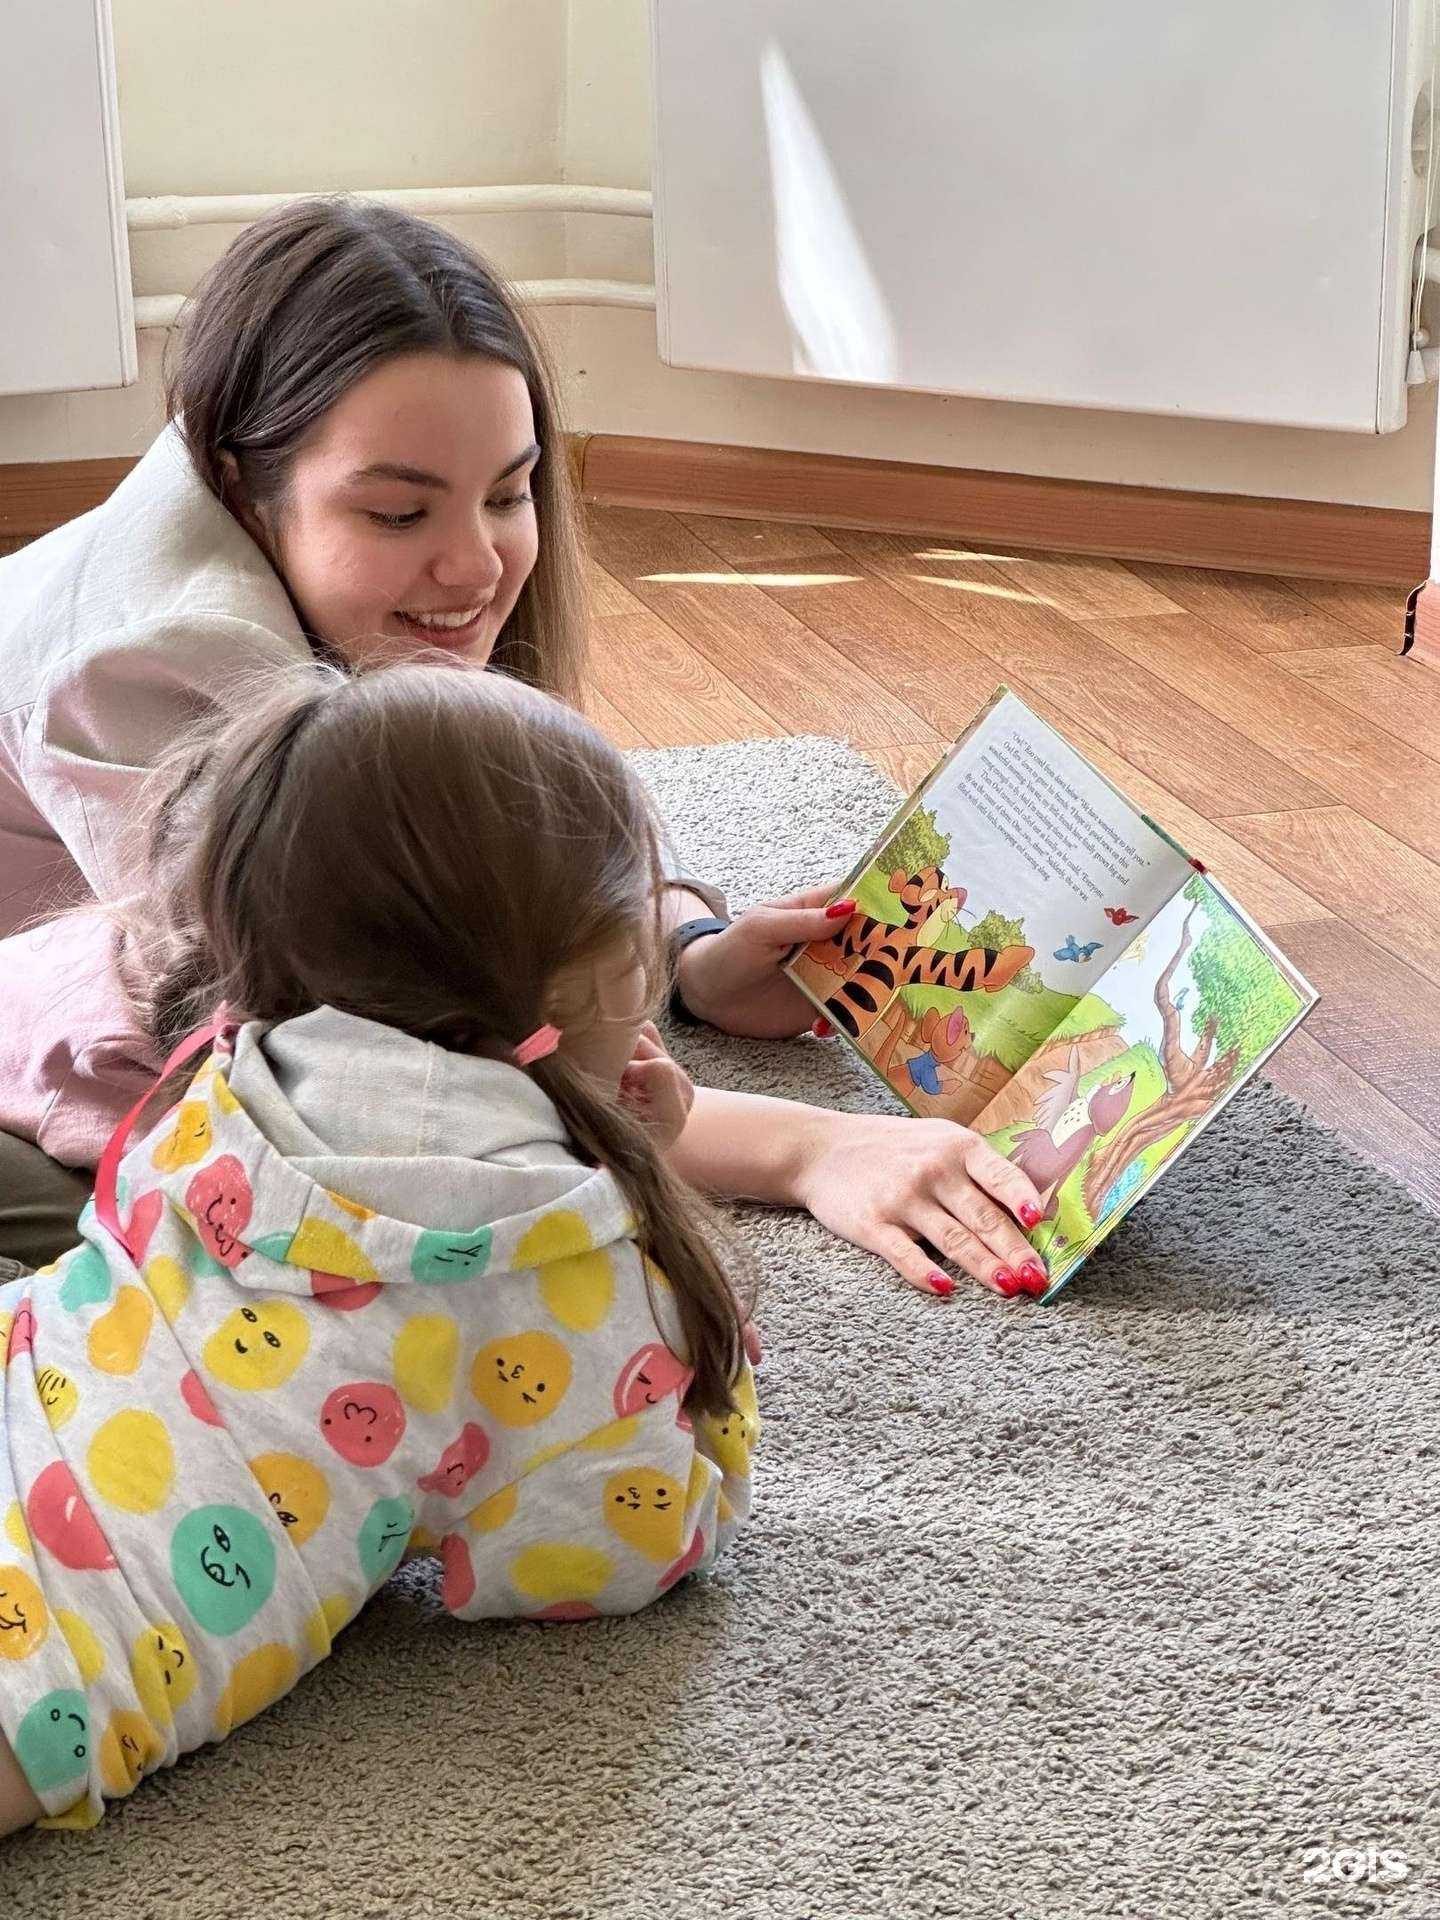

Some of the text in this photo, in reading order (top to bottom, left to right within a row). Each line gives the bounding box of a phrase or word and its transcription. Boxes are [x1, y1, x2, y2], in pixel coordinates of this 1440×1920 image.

[1125, 844, 1135, 854] tell
[1093, 852, 1109, 868] grown
[1118, 855, 1130, 868] this
